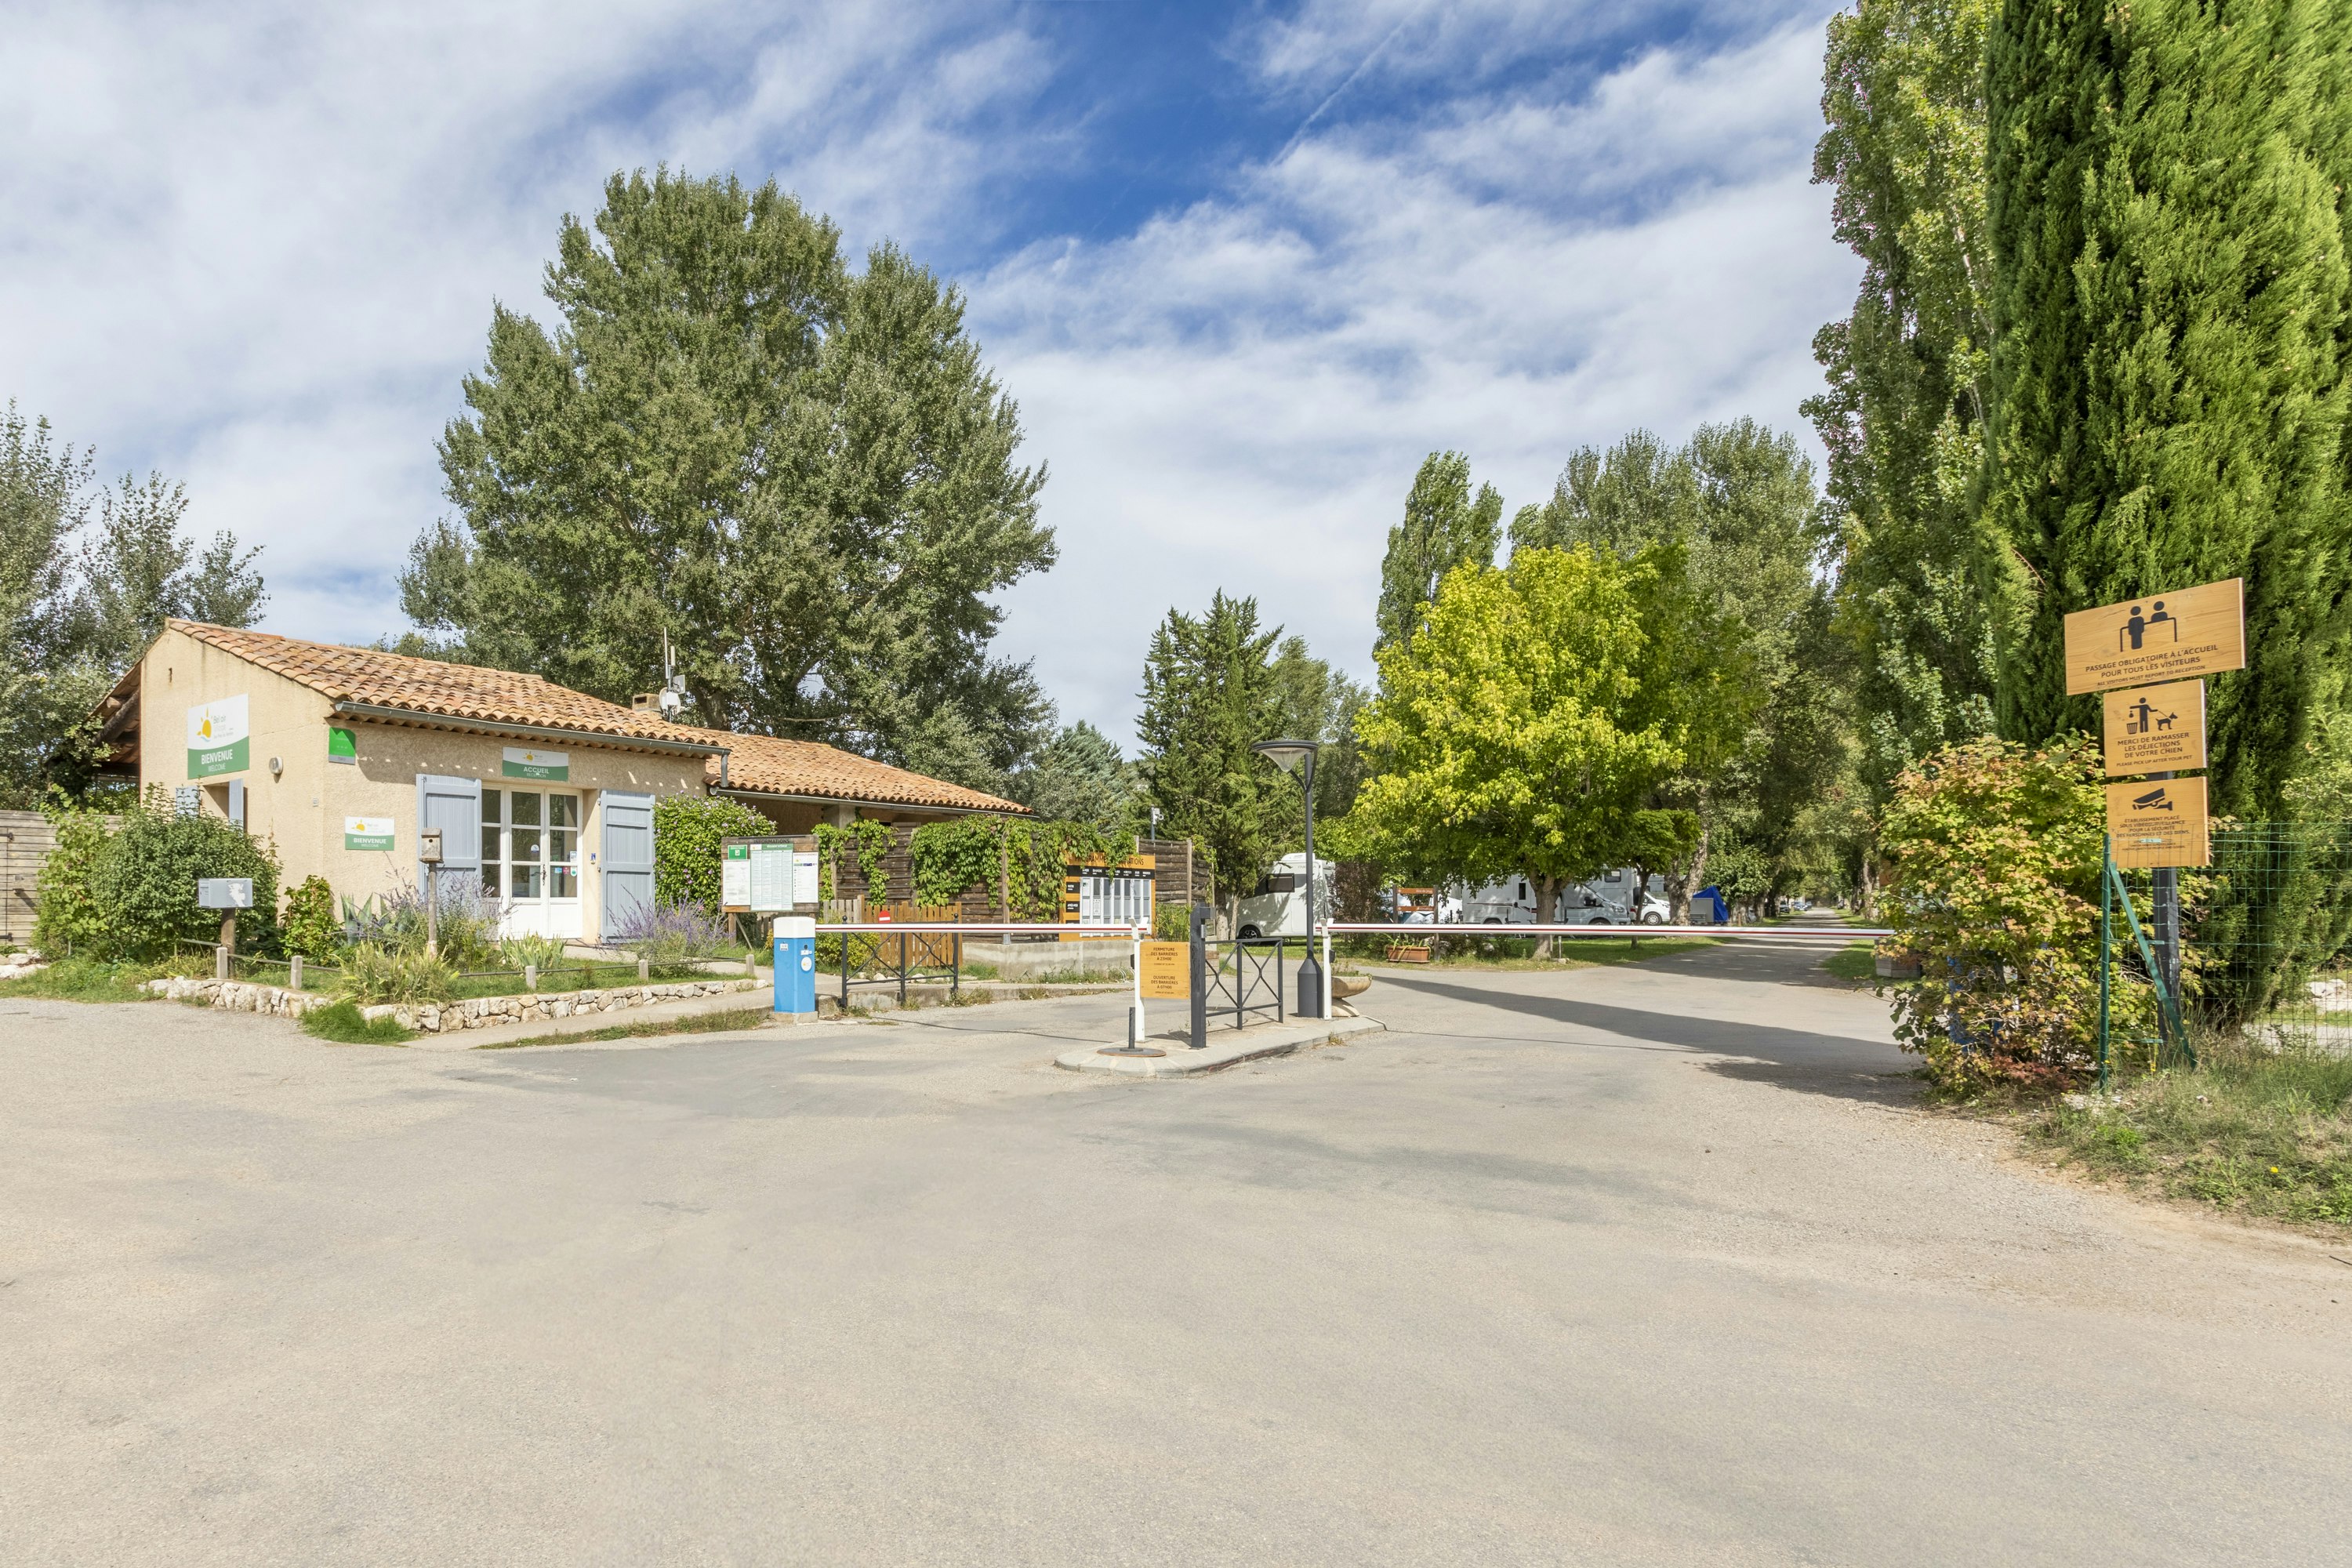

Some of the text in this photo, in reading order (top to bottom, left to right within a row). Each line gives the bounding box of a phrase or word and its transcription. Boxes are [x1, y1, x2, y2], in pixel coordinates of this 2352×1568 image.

[2085, 662, 2116, 672] PASSAGE
[2118, 654, 2168, 666] OBLIGATOIRE
[2177, 644, 2219, 657] L'ACCUEIL
[2101, 670, 2122, 678] POUR
[2160, 656, 2201, 668] VISITEURS
[2175, 665, 2205, 673] RECEPTION
[2151, 732, 2190, 742] RAMASSER
[2137, 740, 2180, 750] DÉJECTIONS
[201, 749, 233, 765] BIENVENUE
[208, 763, 226, 772] WELCOME
